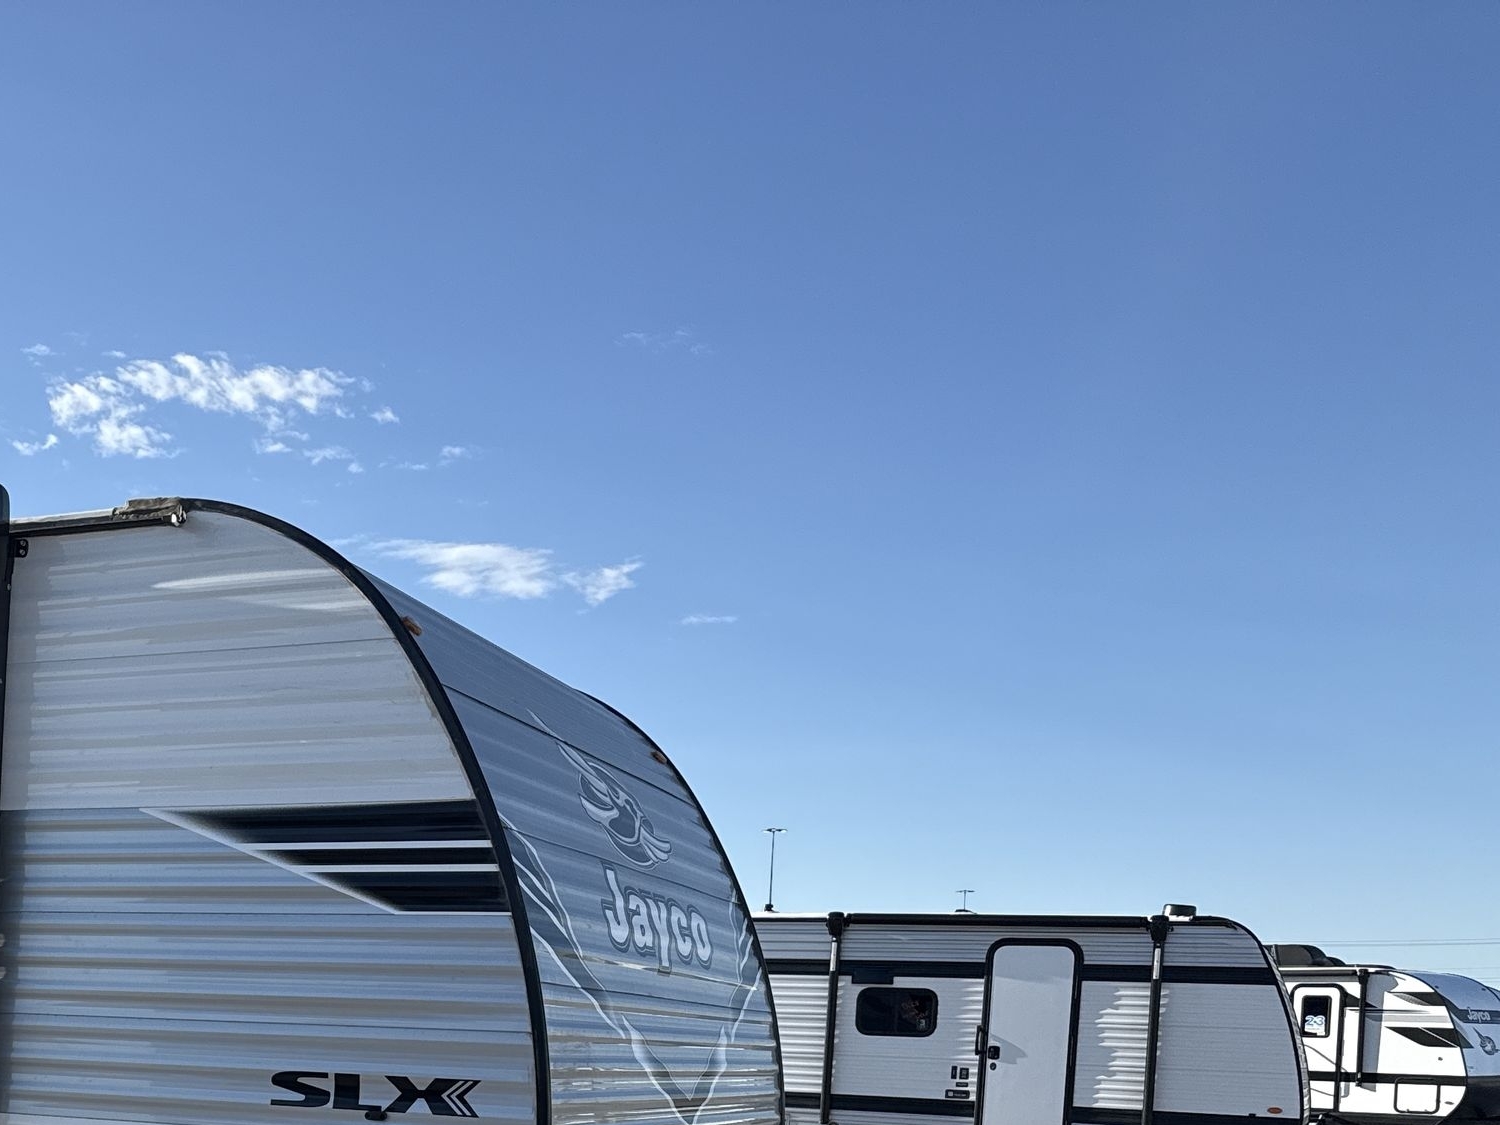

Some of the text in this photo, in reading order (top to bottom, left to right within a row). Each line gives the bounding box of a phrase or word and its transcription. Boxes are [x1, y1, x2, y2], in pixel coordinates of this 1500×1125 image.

[602, 864, 713, 970] Jayco
[1467, 1007, 1491, 1024] Jayco
[270, 1071, 482, 1118] SLX
